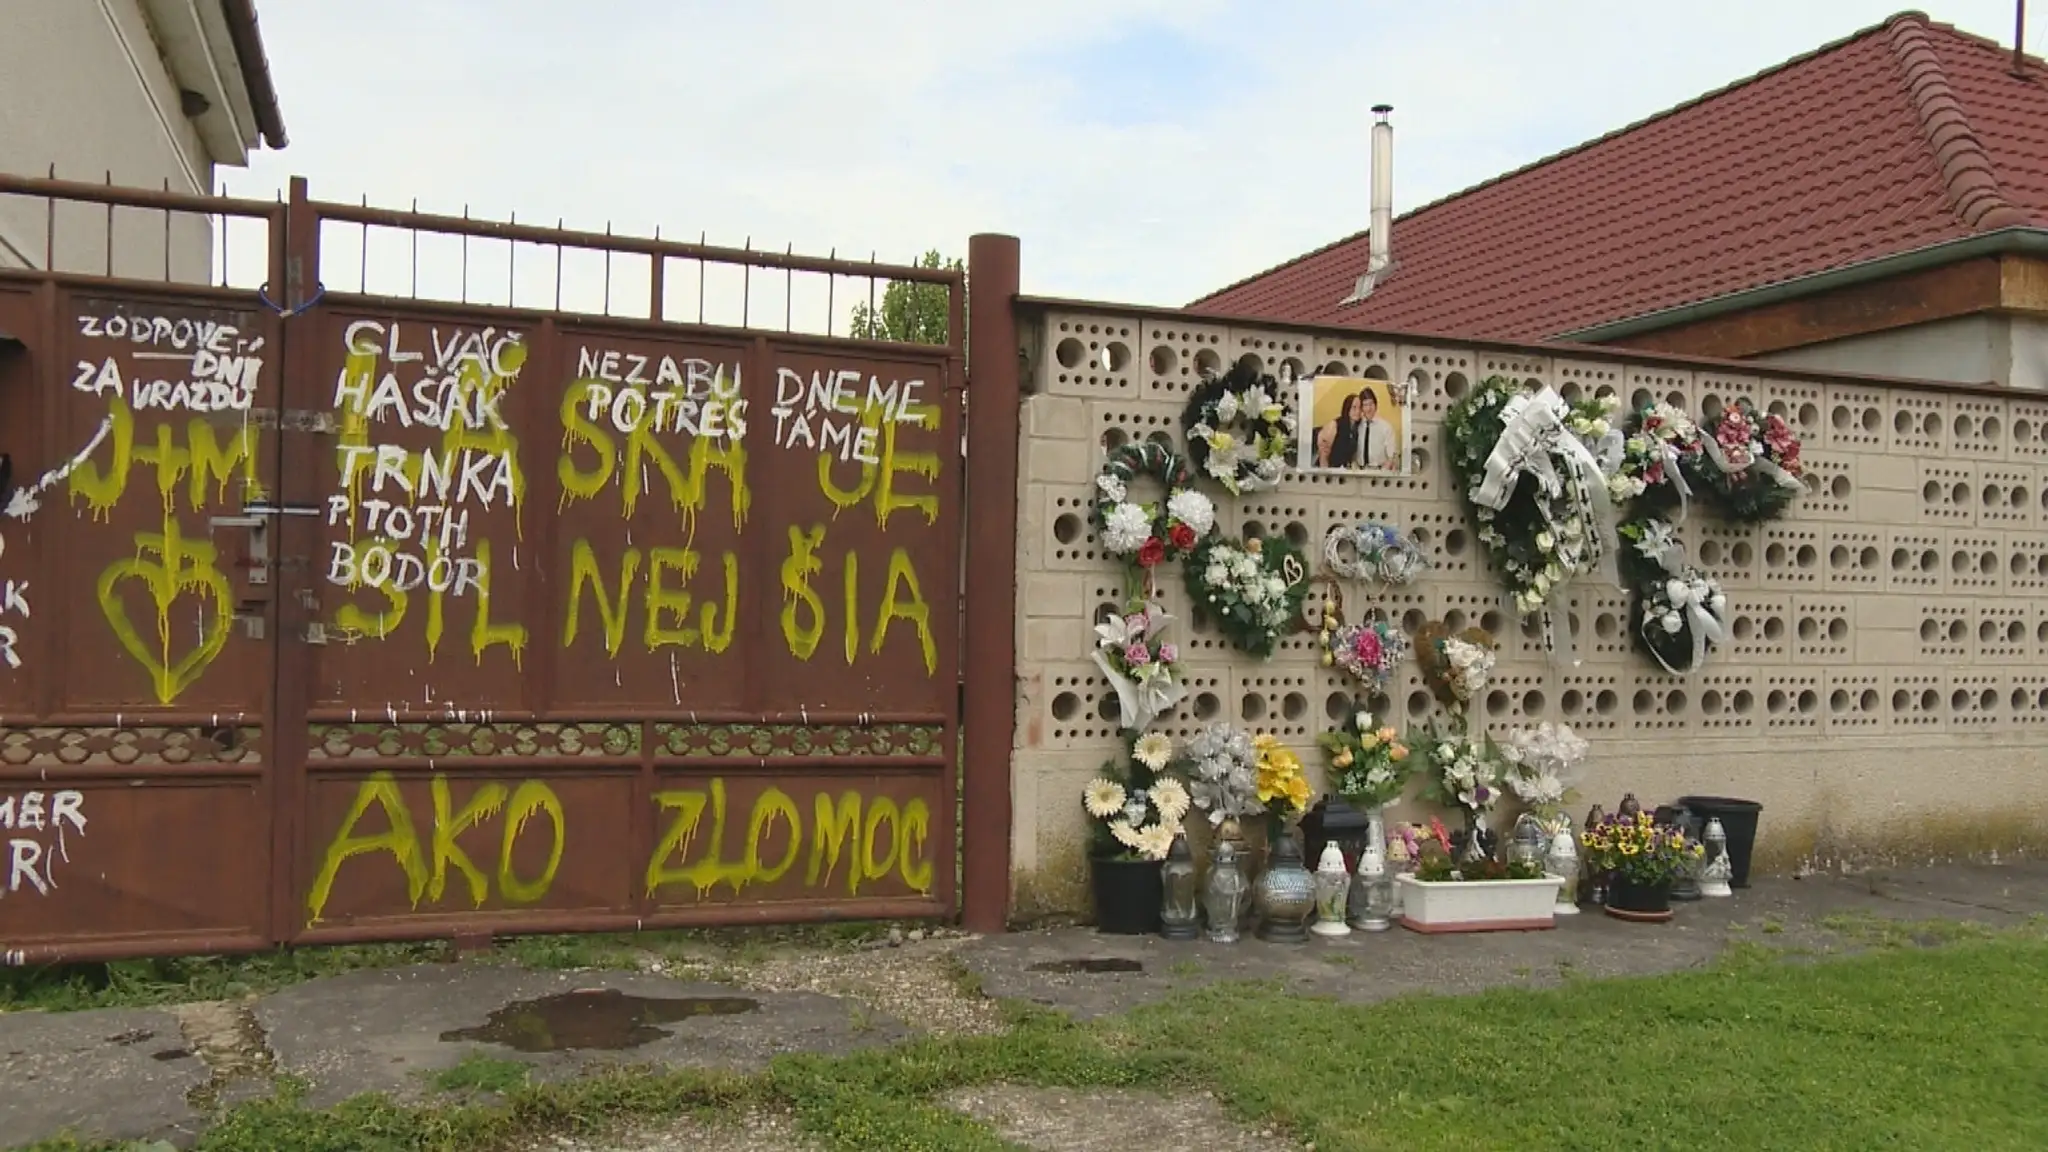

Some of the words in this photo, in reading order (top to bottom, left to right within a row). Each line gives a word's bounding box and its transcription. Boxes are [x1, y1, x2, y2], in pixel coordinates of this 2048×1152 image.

[73, 356, 124, 398] ZA
[578, 346, 742, 400] NEZABU
[776, 366, 926, 424] DNEME
[586, 384, 749, 440] POTRES
[771, 407, 880, 465] TÁME
[336, 444, 514, 508] TRNKA
[362, 499, 468, 550] TOTH
[327, 535, 489, 596] BÖDÖR
[306, 770, 566, 926] AKO
